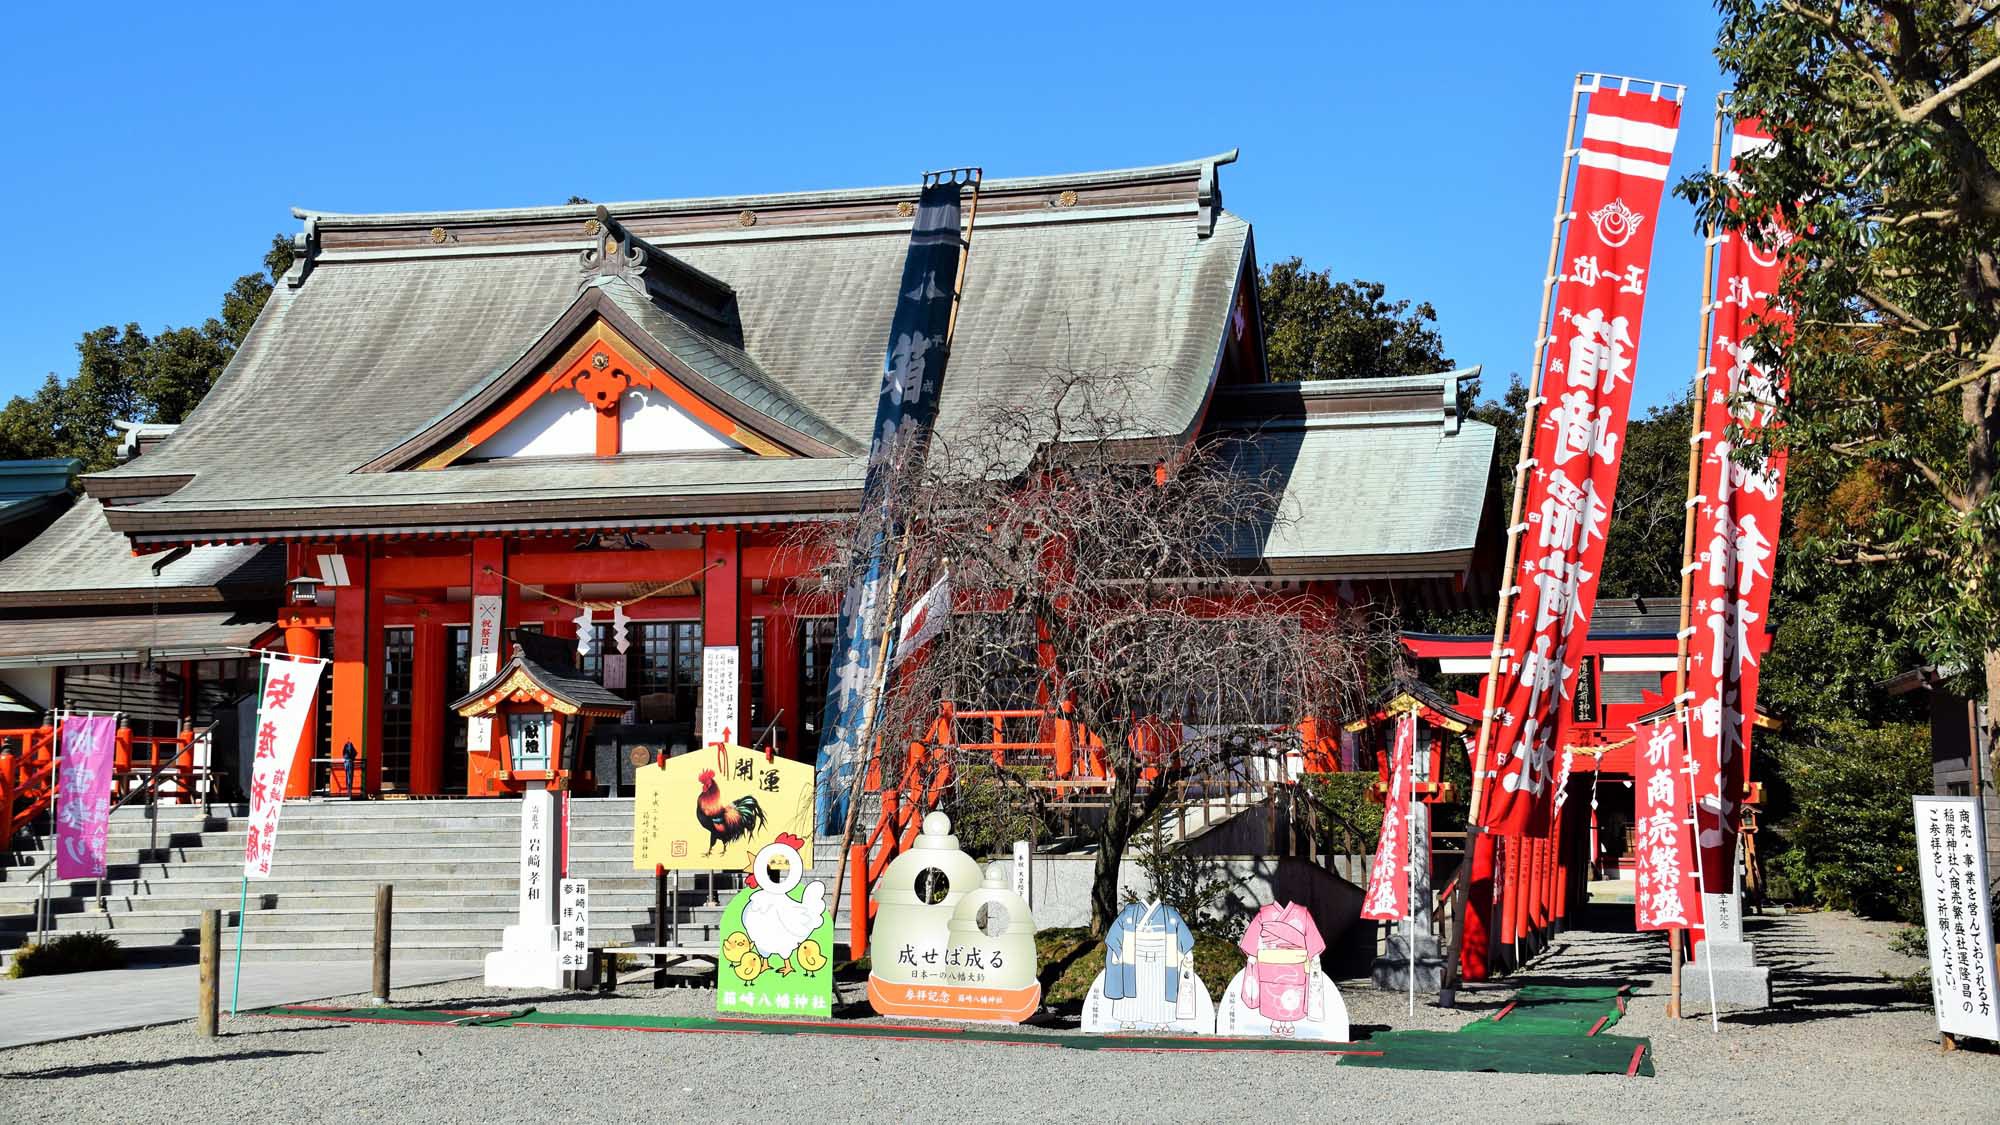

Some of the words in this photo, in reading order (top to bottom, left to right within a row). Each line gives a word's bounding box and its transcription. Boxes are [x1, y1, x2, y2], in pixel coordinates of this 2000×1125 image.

[733, 758, 780, 793] 開運
[1644, 725, 1687, 926] 祈商売繁盛
[562, 884, 574, 965] 参拝記念
[1944, 809, 1973, 1014] 稲荷神社へ商売繁盛社運隆昌の
[898, 944, 1003, 970] 成せば成る
